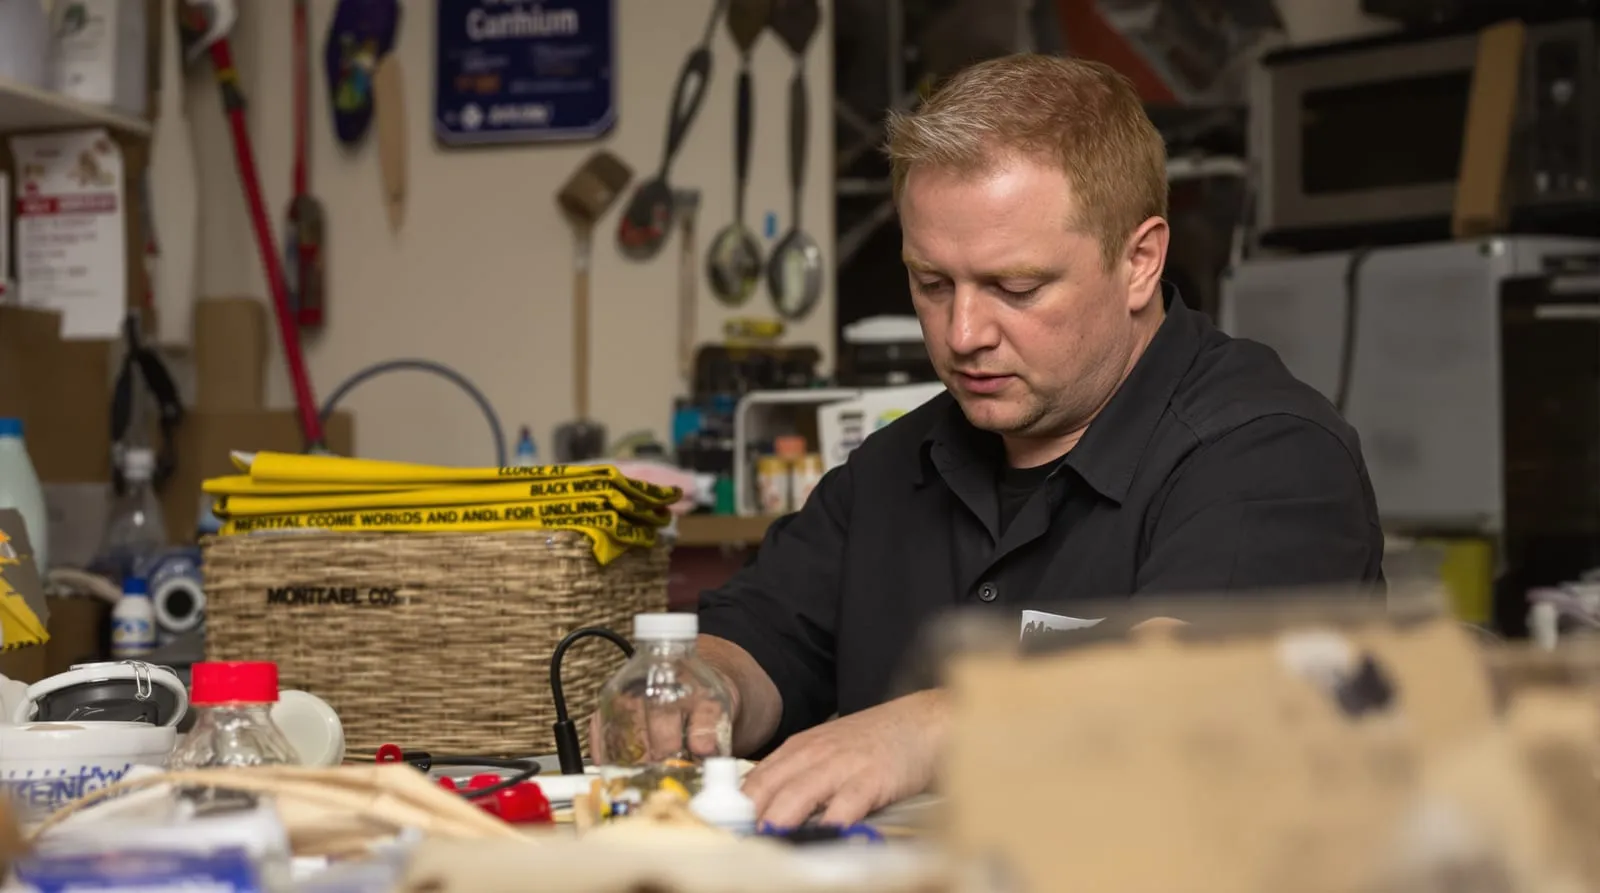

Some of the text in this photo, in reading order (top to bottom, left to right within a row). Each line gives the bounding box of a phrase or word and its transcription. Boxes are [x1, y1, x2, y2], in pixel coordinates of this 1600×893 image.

[530, 482, 569, 497] BLACK
[427, 510, 458, 524] AND
[504, 506, 535, 520] FOR
